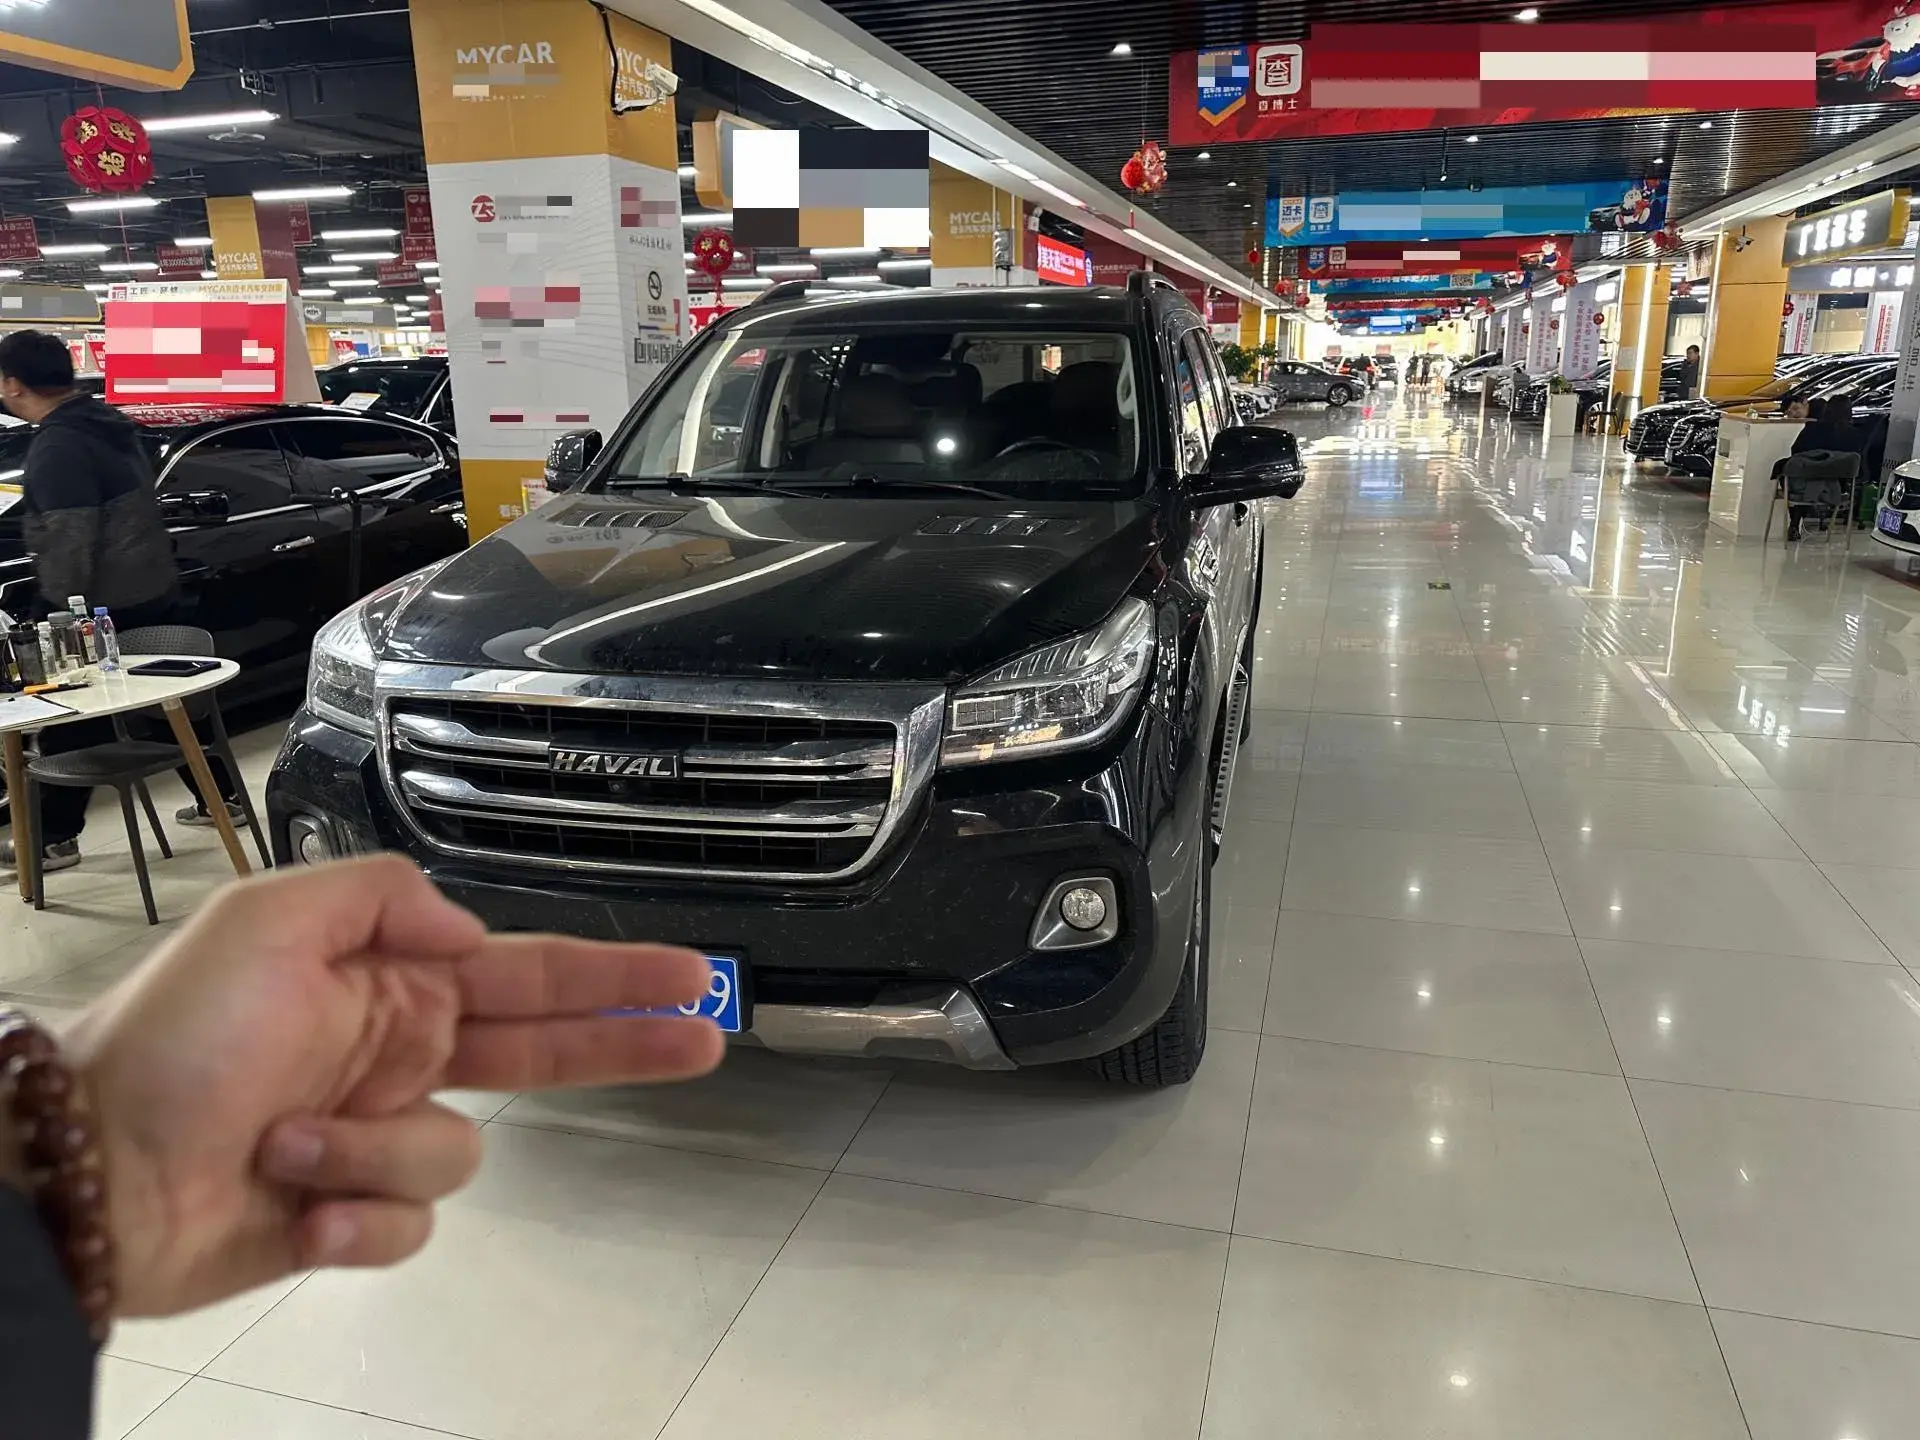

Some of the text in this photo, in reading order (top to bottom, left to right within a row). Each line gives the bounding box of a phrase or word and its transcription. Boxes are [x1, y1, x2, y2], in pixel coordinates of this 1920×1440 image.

[456, 42, 554, 63] MYCAR
[1258, 98, 1299, 112] 查博士
[1282, 206, 1302, 216] 迈卡
[218, 252, 257, 264] MYCAR
[553, 752, 671, 776] HAVAL
